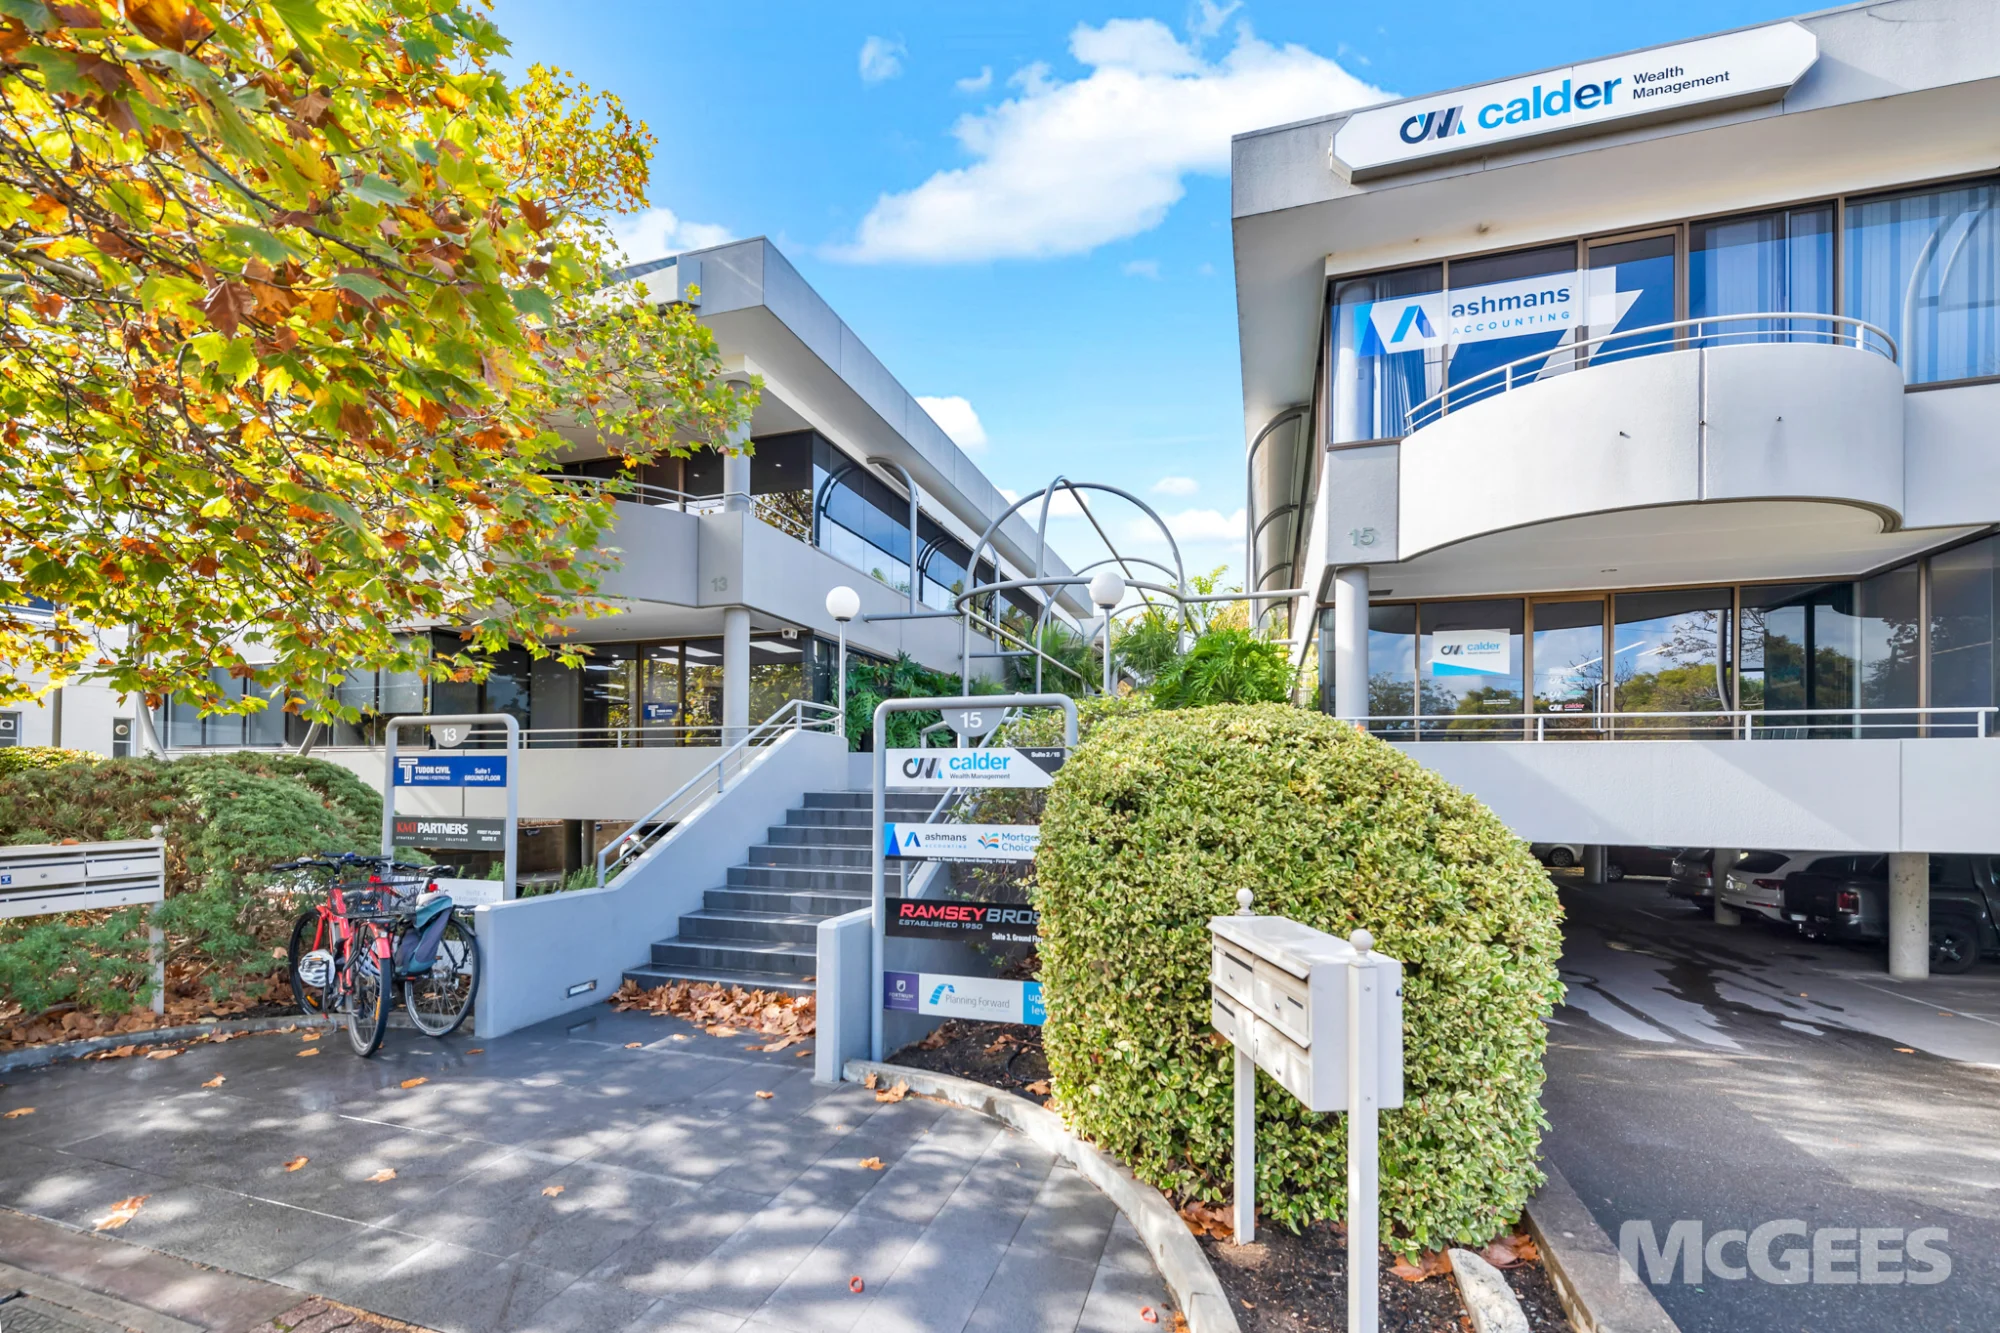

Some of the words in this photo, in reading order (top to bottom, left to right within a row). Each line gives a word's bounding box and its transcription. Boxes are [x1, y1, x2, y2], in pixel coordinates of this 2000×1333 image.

[1633, 65, 1685, 85] Wealth
[1632, 69, 1731, 101] Management
[1477, 77, 1623, 130] calder
[1451, 287, 1571, 318] ashmans
[1451, 310, 1571, 336] ACCOUNTING
[1348, 527, 1375, 546] 15
[711, 576, 728, 592] 13
[1467, 641, 1501, 651] calder
[959, 711, 983, 728] 15
[441, 728, 457, 742] 13
[949, 752, 1011, 771] calder
[414, 766, 434, 774] TUDOR
[435, 766, 451, 774] CIVIL
[417, 822, 468, 834] PARTNERS
[925, 833, 967, 842] ashmans
[898, 919, 958, 928] ESTABLISHED
[992, 932, 1005, 941] Suite
[1012, 934, 1031, 942] Ground
[946, 994, 977, 1008] Planning
[978, 998, 1010, 1008] Forward
